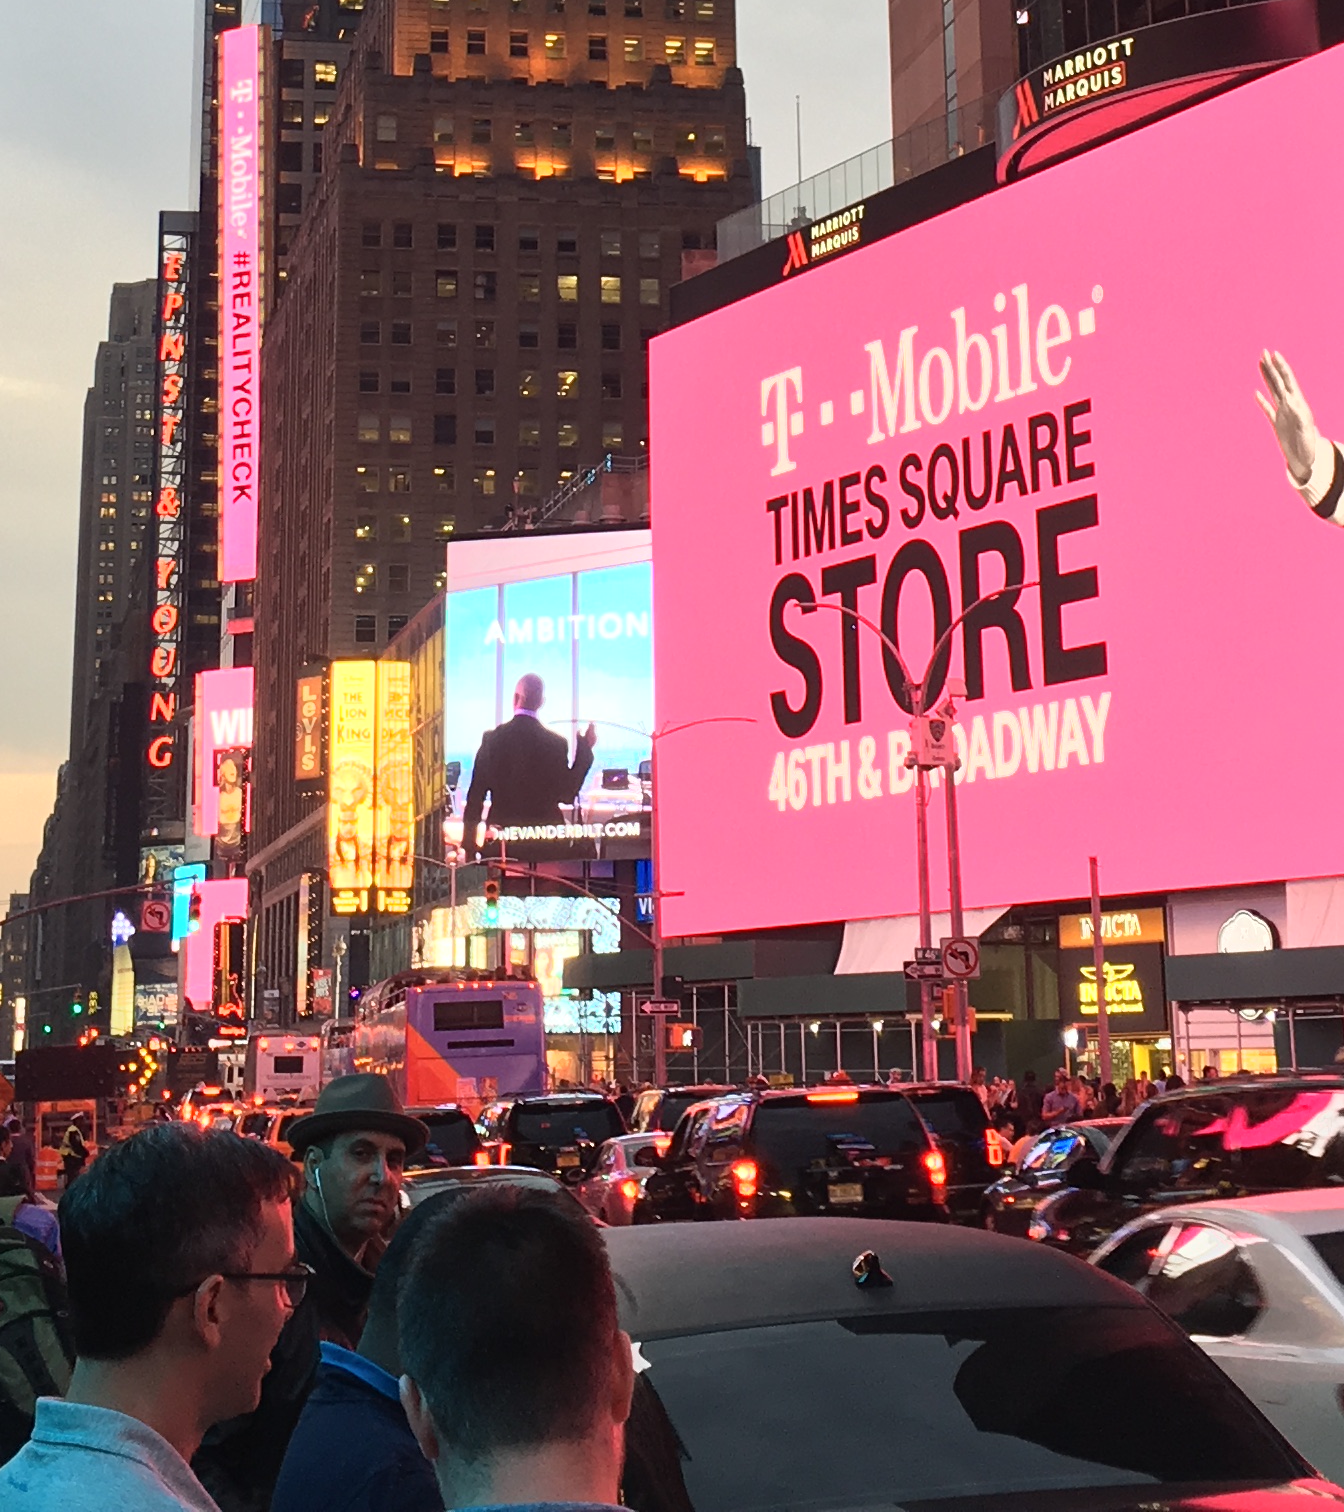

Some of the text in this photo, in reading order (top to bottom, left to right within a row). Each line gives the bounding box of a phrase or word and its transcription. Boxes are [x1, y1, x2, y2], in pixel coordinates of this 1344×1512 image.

[1042, 37, 1134, 88] MARRIOTT
[1044, 66, 1123, 112] MARQUIS
[810, 204, 865, 240] MARRIOTT
[811, 226, 859, 258] MARQUIS
[231, 251, 254, 504] #REALITYCHECK
[156, 486, 182, 517] &
[766, 398, 1097, 567] TIMES SQUARE
[483, 610, 650, 646] AMBITION
[768, 492, 1109, 740] STORE
[148, 557, 178, 767] YOUNG
[339, 704, 367, 722] LION
[343, 691, 363, 702] THE
[336, 723, 372, 745] KING
[767, 691, 1112, 812] 46TH & BOADWAY
